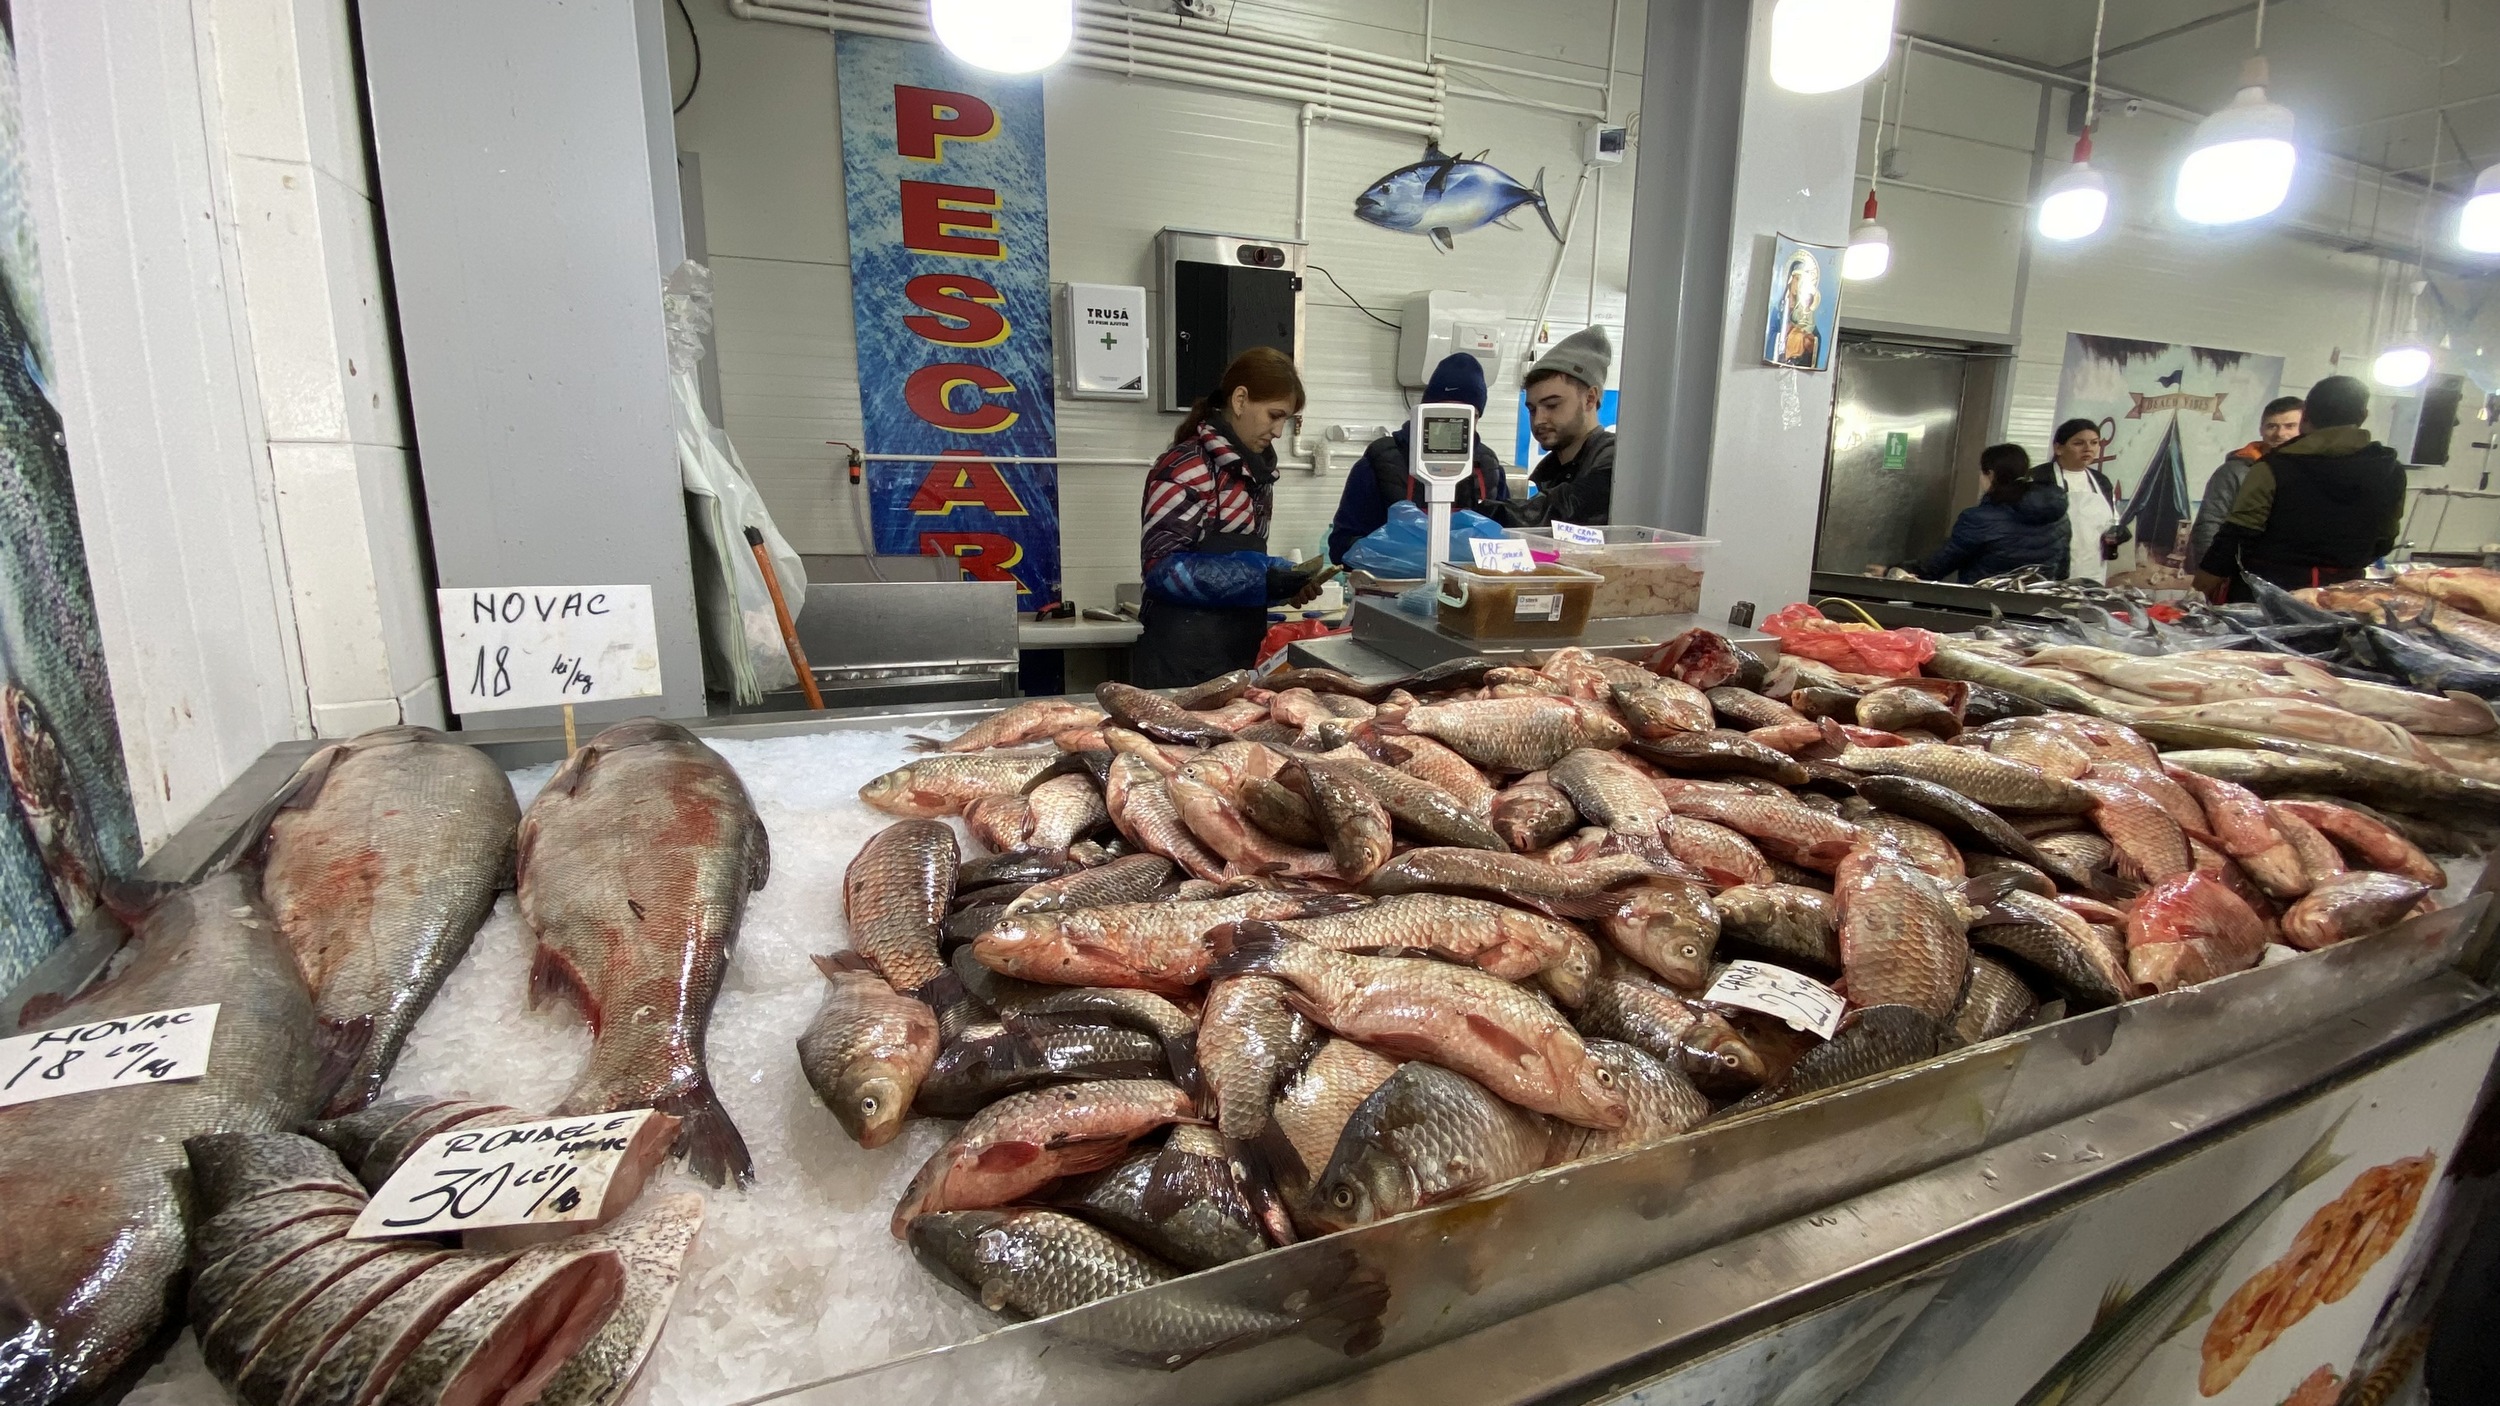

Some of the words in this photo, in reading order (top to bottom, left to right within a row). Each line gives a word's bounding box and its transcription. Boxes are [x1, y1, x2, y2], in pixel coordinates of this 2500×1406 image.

[1087, 308, 1129, 320] TRUSĂ
[2146, 398, 2178, 410] BEACH
[2184, 398, 2209, 410] VIBES
[1479, 542, 1503, 557] ICRE
[473, 592, 610, 623] NOVAC
[470, 645, 511, 697] 18
[30, 1012, 194, 1051] NOVAC
[4, 1050, 85, 1090] 18
[442, 1117, 635, 1158] RONDELE
[382, 1162, 515, 1228] 30
